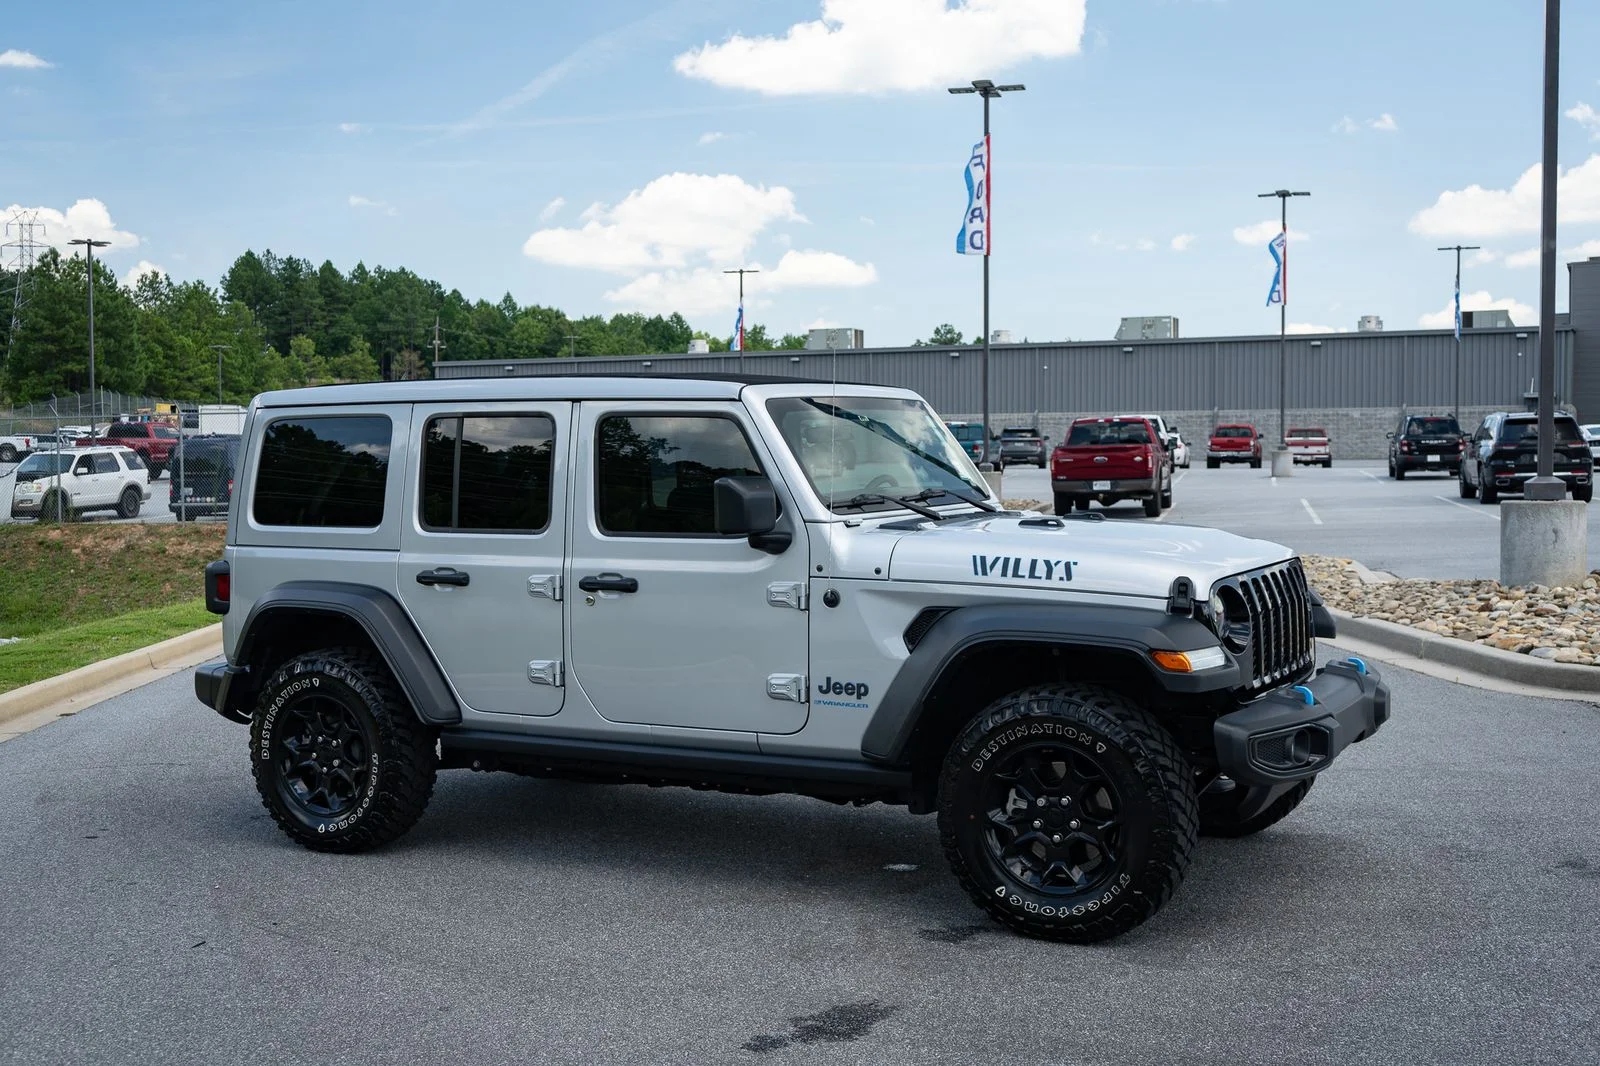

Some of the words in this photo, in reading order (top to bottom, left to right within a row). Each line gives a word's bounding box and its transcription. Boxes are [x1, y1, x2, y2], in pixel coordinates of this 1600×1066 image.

[972, 555, 1078, 582] WILLYS
[818, 676, 869, 700] Jeep
[822, 700, 869, 709] WRANGLER
[261, 678, 311, 760] DESTINATION
[971, 723, 1093, 772] DESTINATION
[1009, 872, 1131, 918] Firestone
